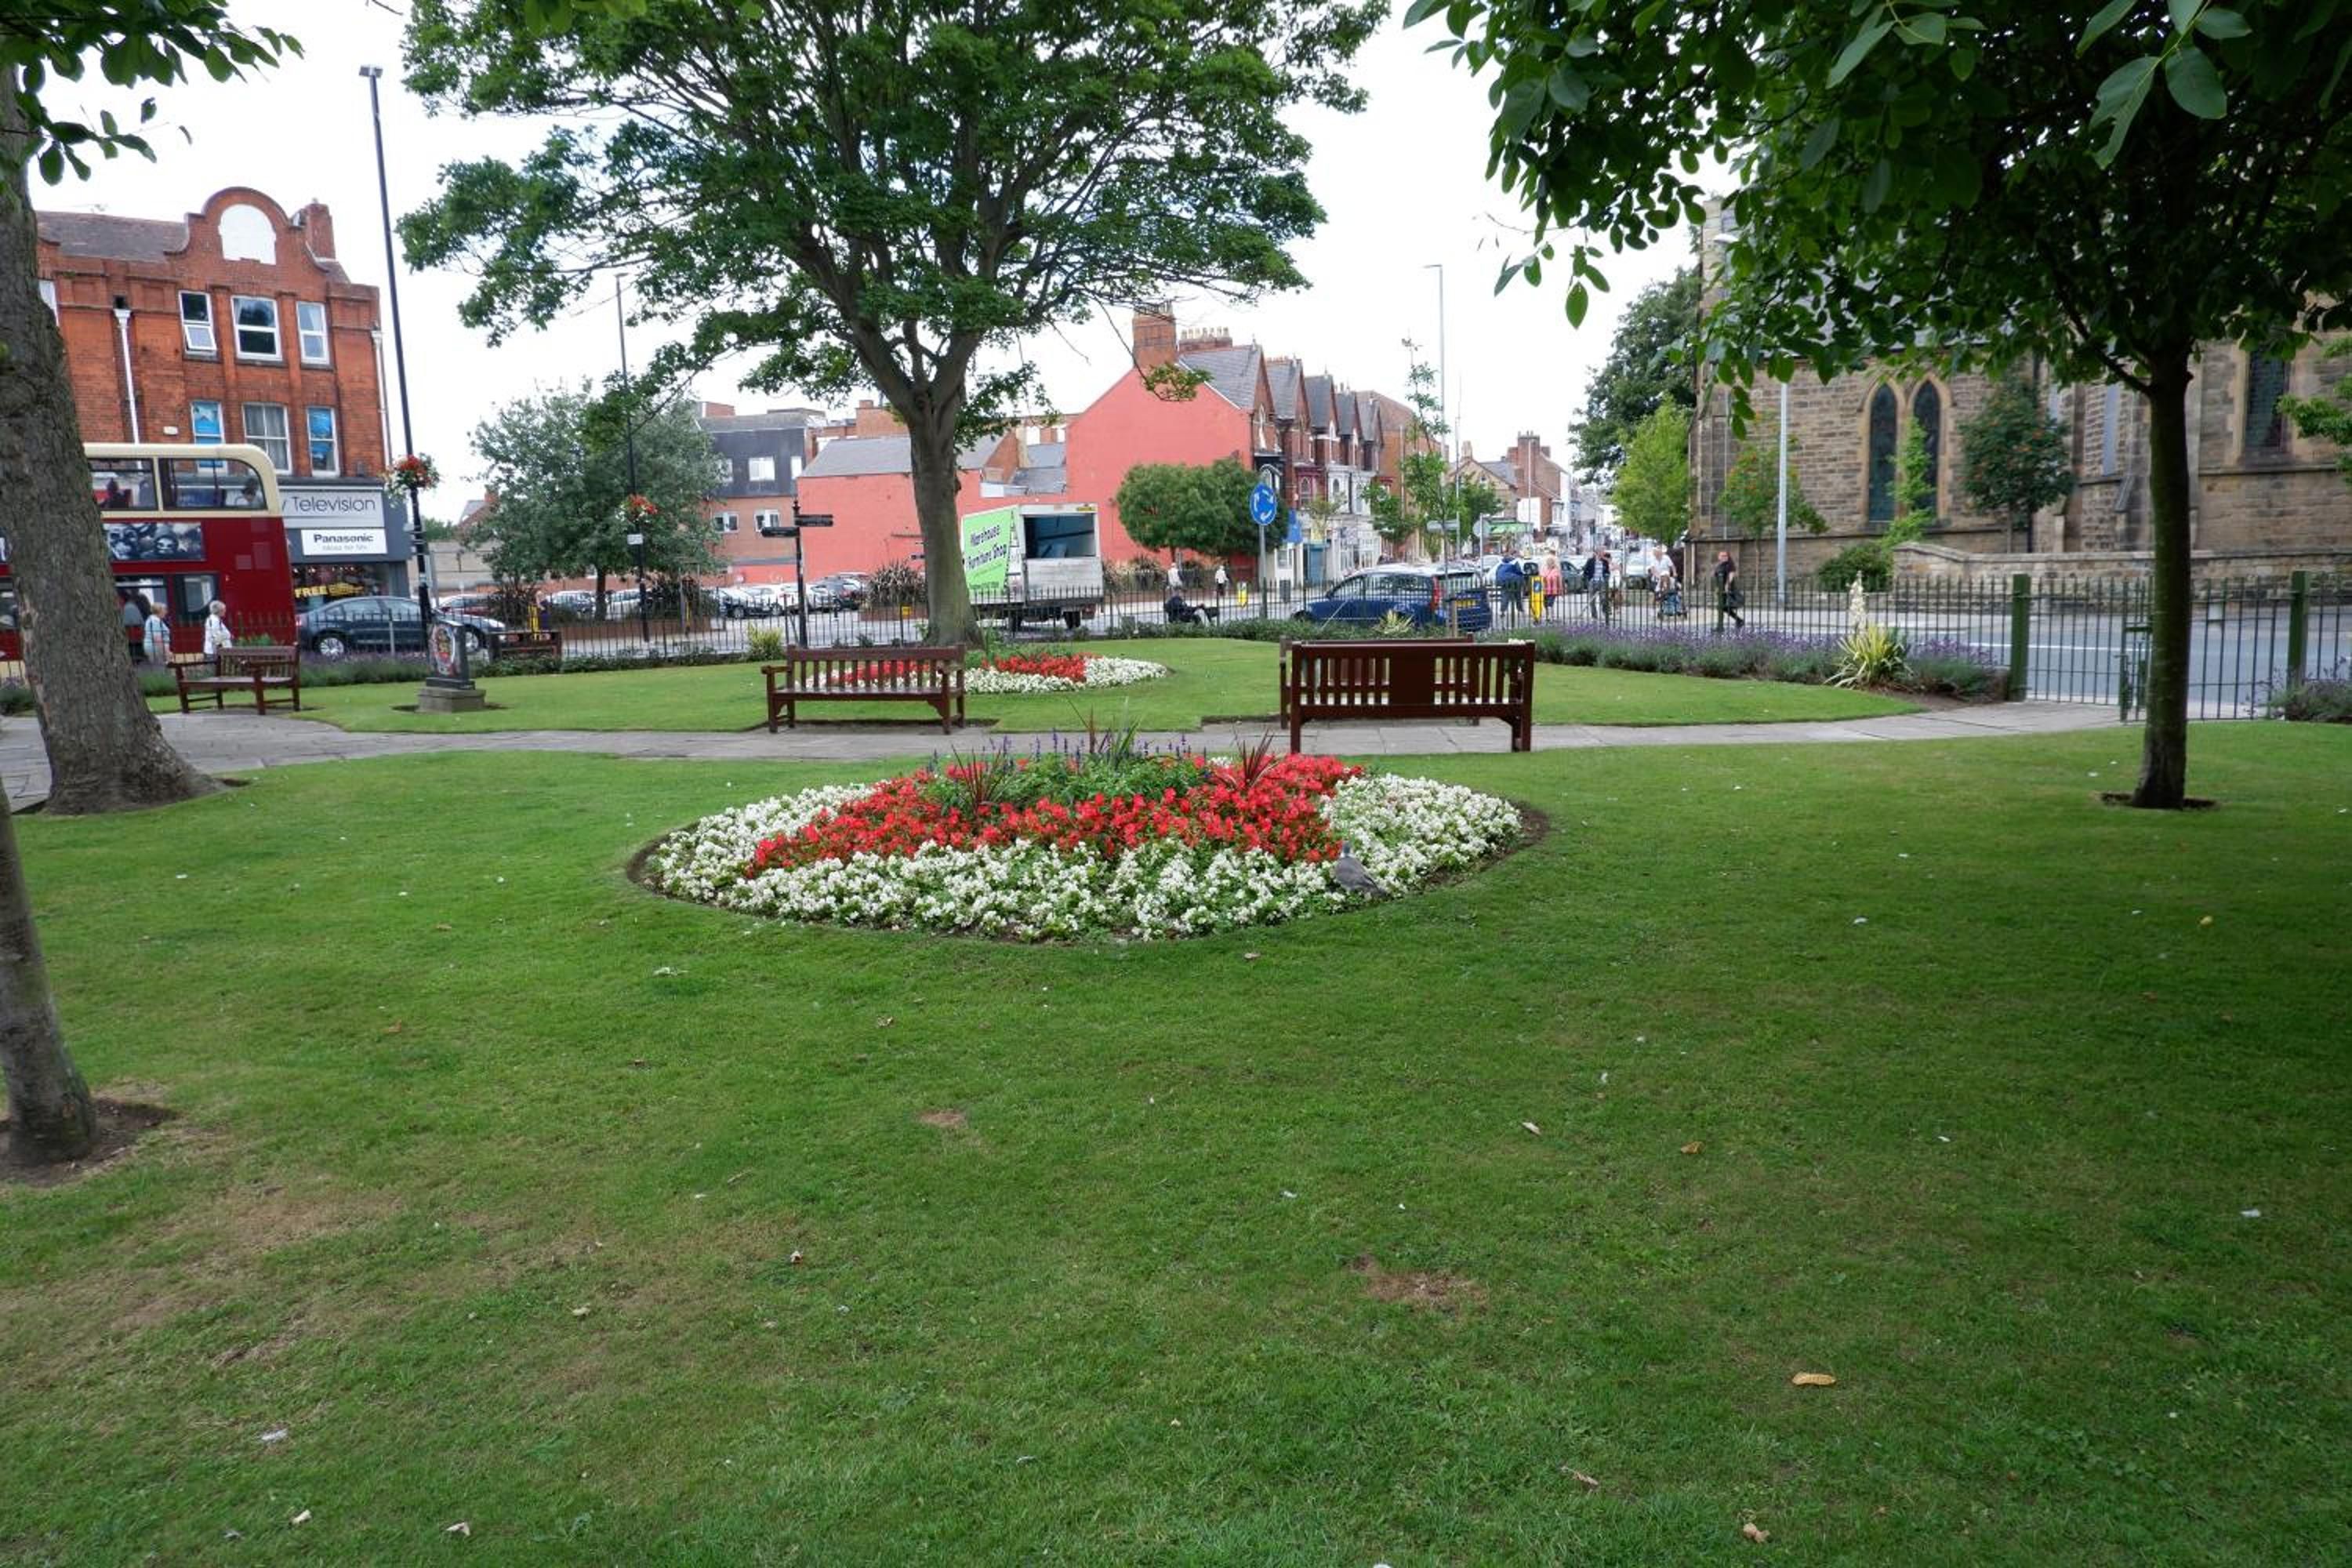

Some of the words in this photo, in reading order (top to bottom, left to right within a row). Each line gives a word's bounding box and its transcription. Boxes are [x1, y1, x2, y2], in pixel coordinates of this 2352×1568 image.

[291, 496, 376, 512] Television
[314, 533, 374, 543] Panasonic
[294, 585, 328, 598] FREE
